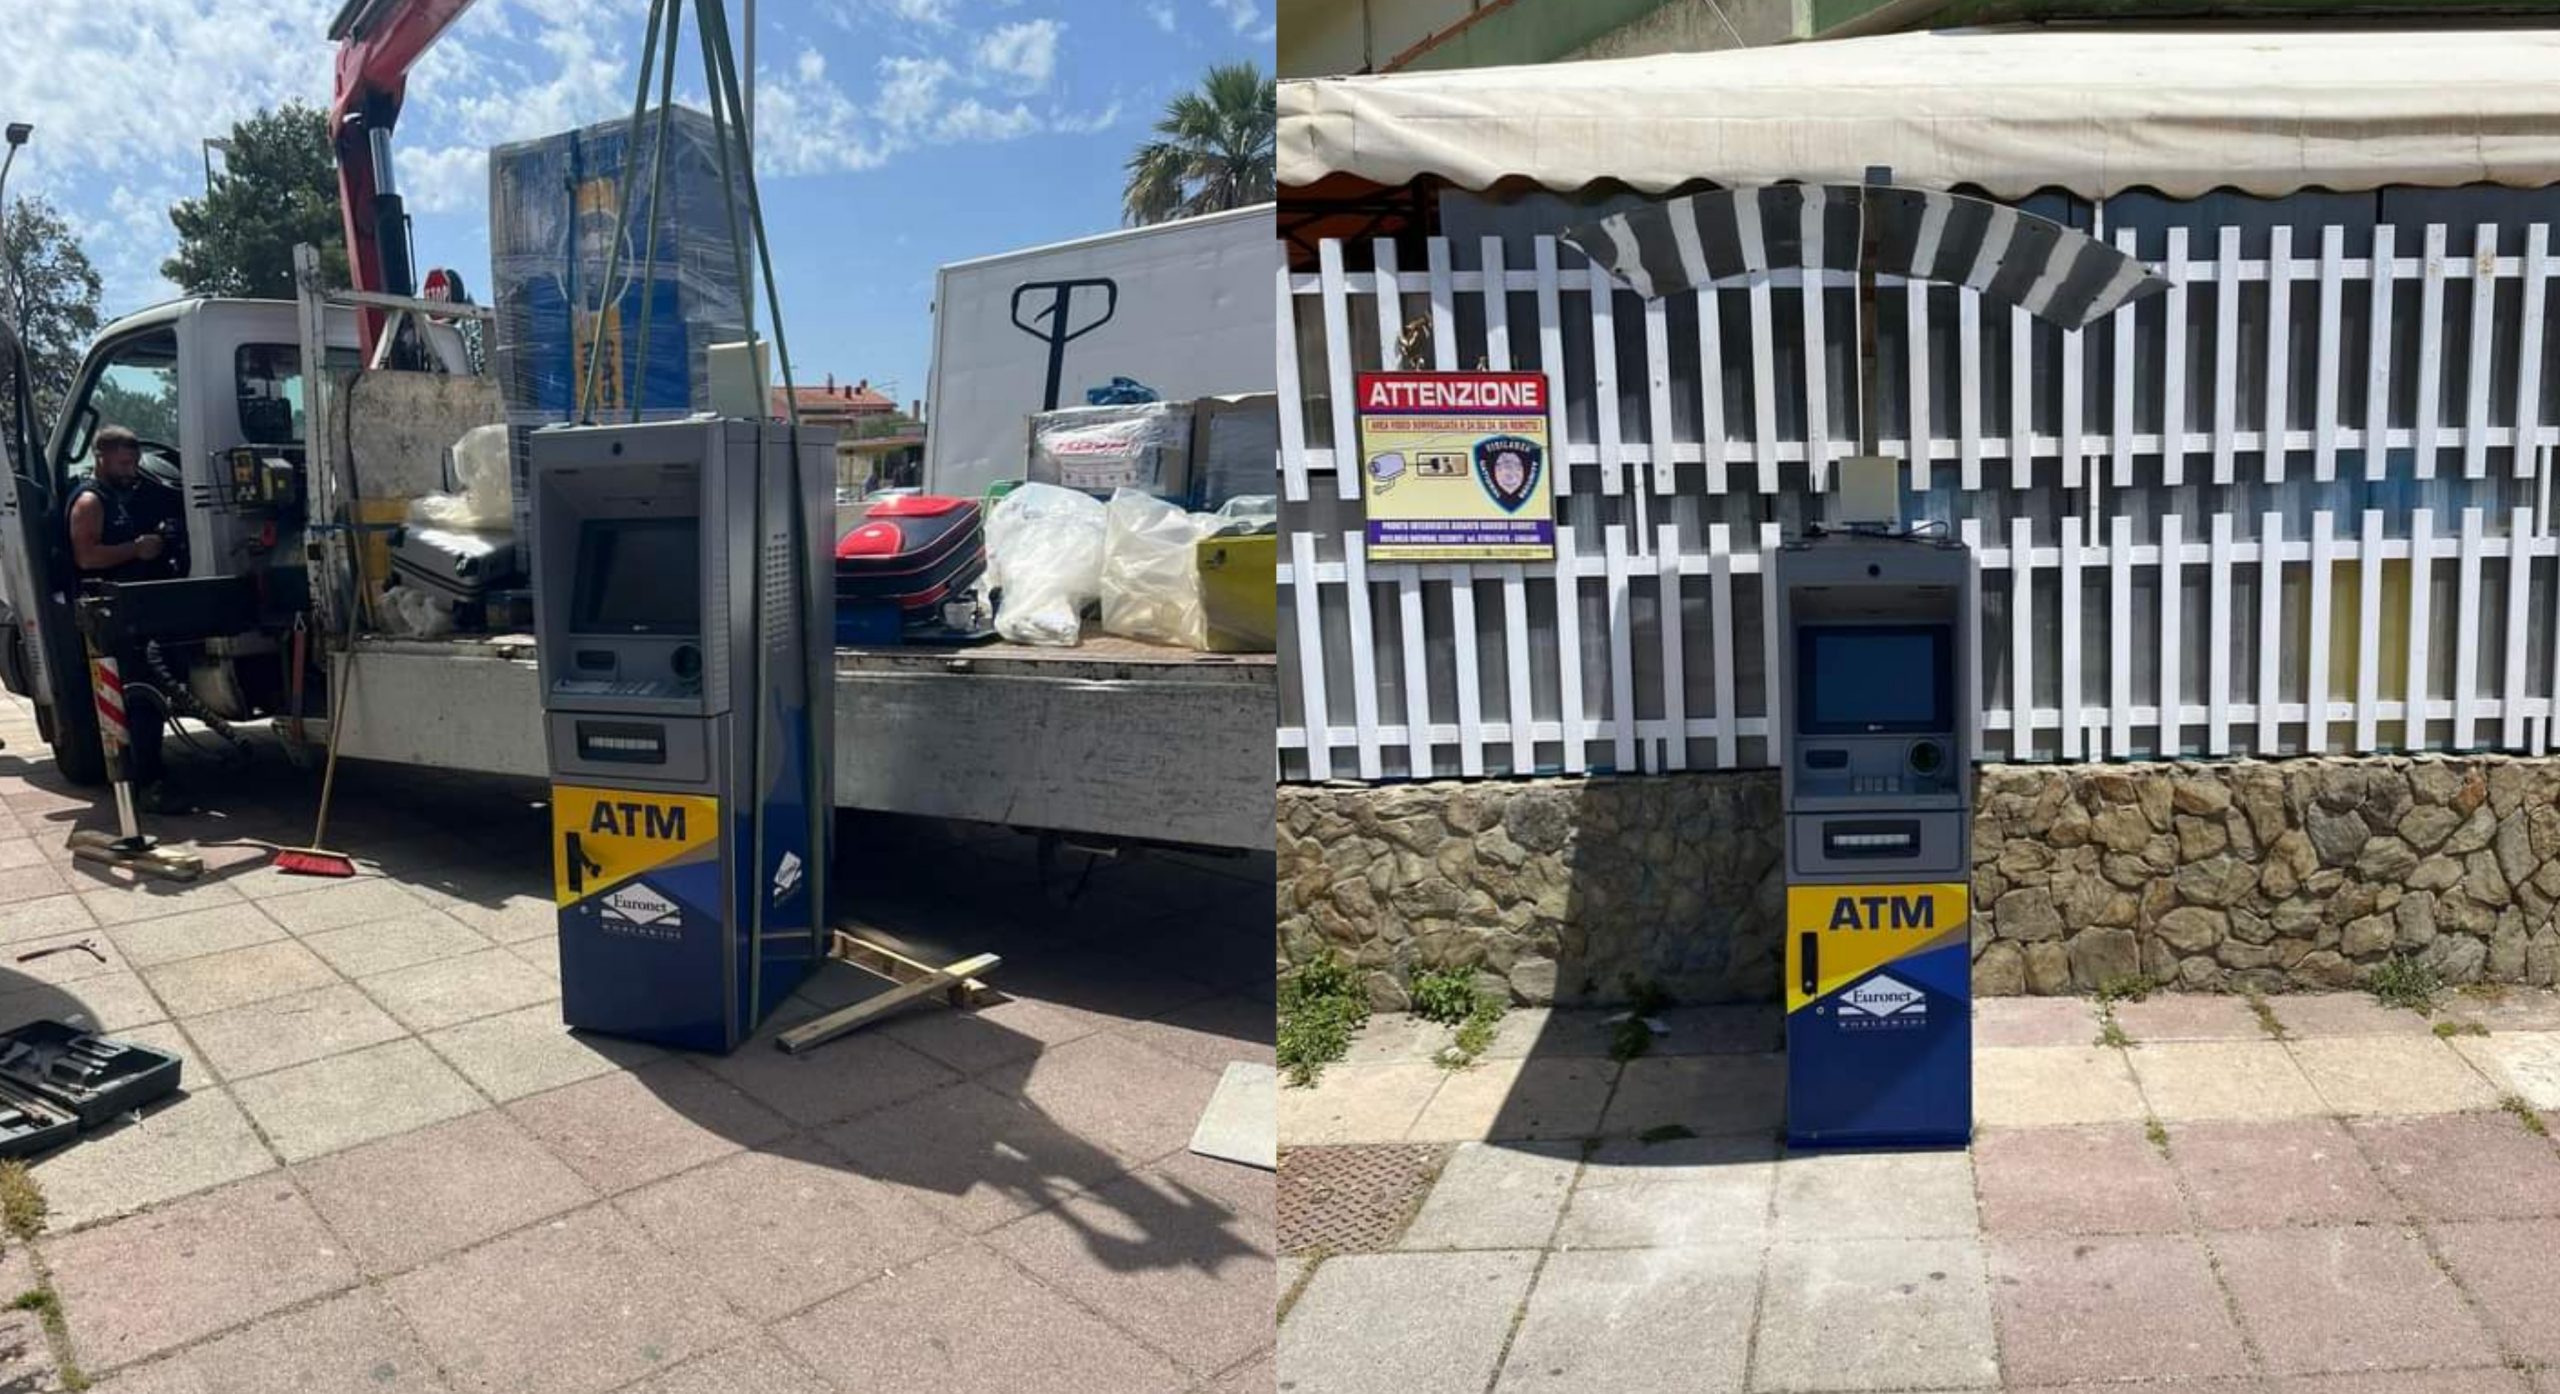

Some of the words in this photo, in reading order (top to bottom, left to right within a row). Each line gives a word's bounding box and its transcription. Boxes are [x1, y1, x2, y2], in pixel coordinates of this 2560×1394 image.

[1369, 381, 1538, 406] ATTENZIONE
[590, 801, 686, 841] ATM
[614, 894, 668, 913] Euronet
[1829, 894, 1934, 930] ATM
[1853, 990, 1913, 1003] Euronet
